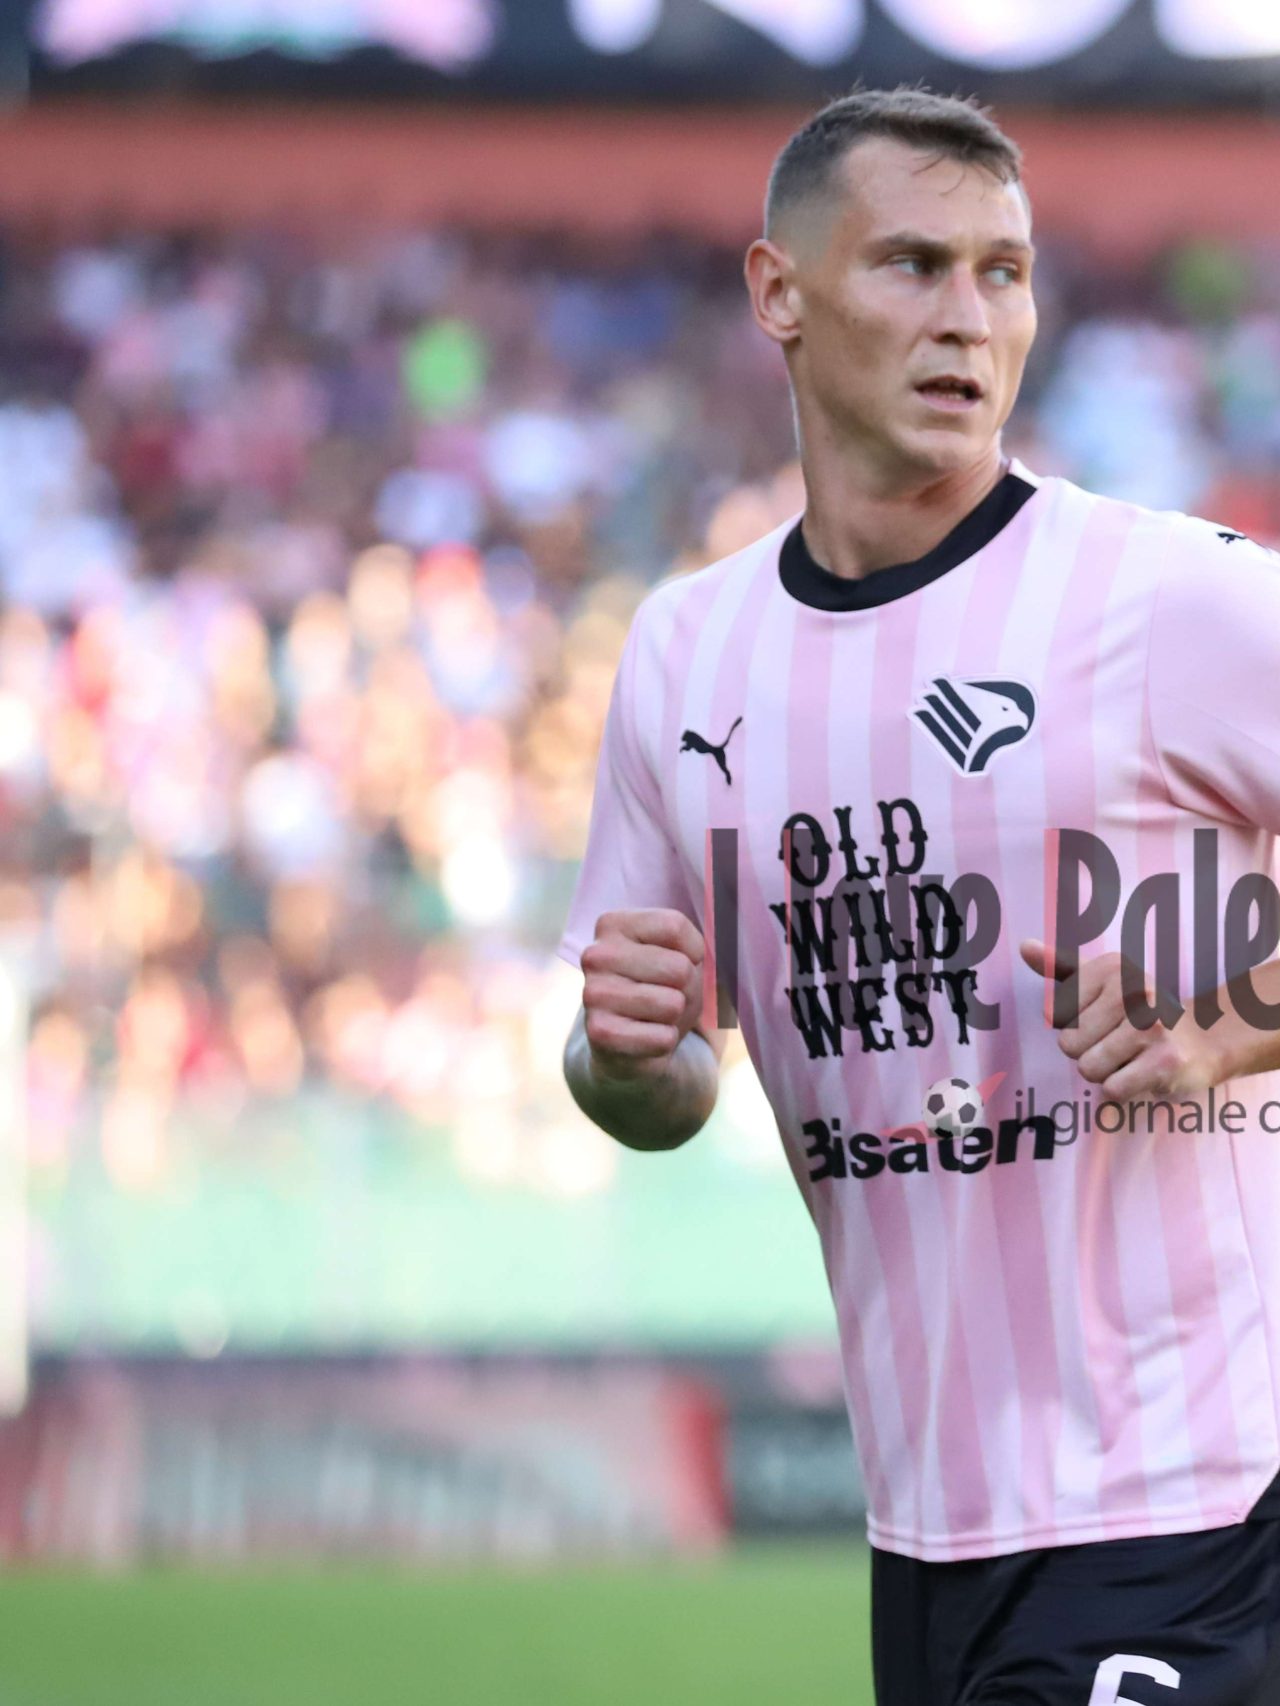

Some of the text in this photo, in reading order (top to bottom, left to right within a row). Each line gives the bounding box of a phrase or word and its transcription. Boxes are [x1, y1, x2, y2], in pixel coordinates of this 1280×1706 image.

[778, 798, 928, 887] OLD
[769, 883, 964, 975] WILD
[785, 969, 977, 1060] WEST
